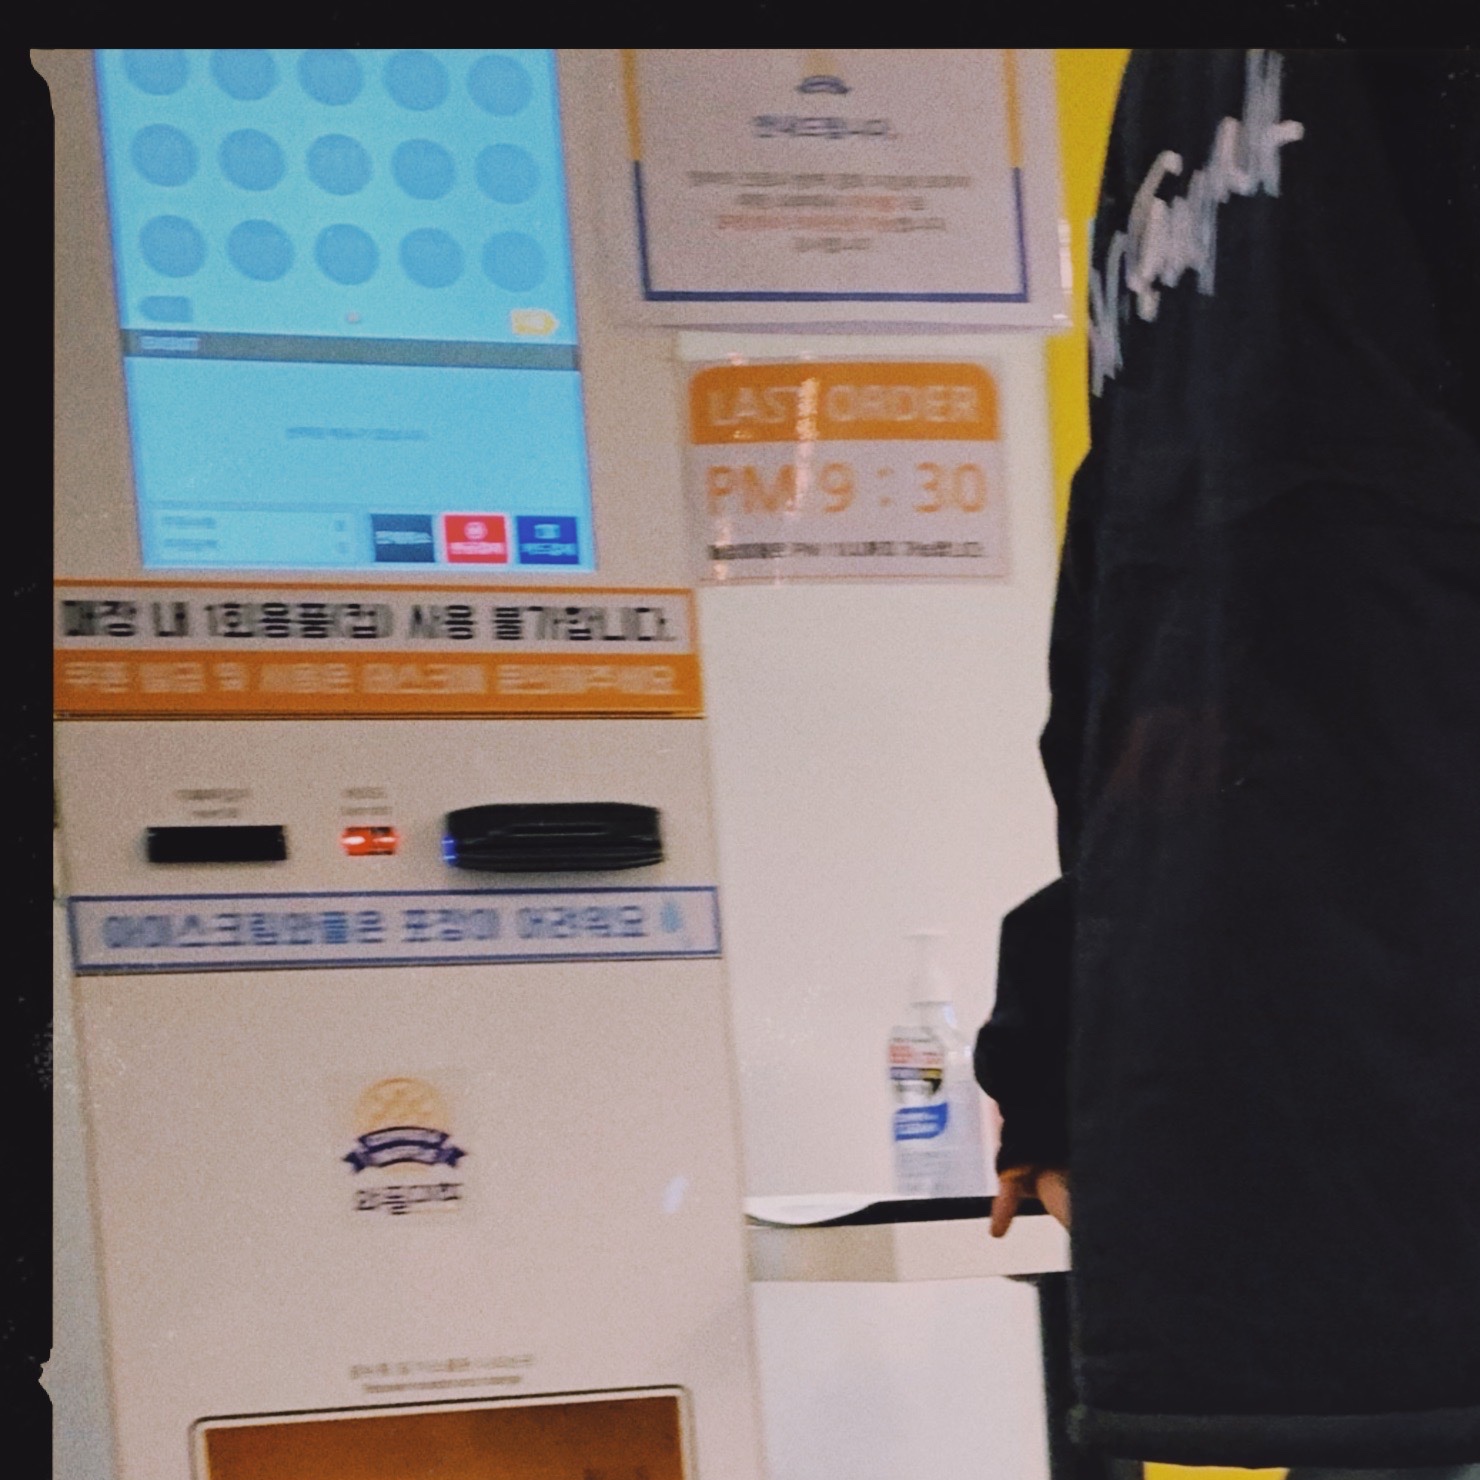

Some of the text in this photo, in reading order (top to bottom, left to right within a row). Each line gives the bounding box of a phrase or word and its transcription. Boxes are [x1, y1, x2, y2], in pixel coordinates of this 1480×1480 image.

[826, 383, 980, 423] ORDER
[706, 463, 798, 515] PM
[61, 599, 138, 638] 매장
[152, 601, 190, 638] 내
[408, 604, 476, 640] 사용
[401, 906, 500, 943] 포장이
